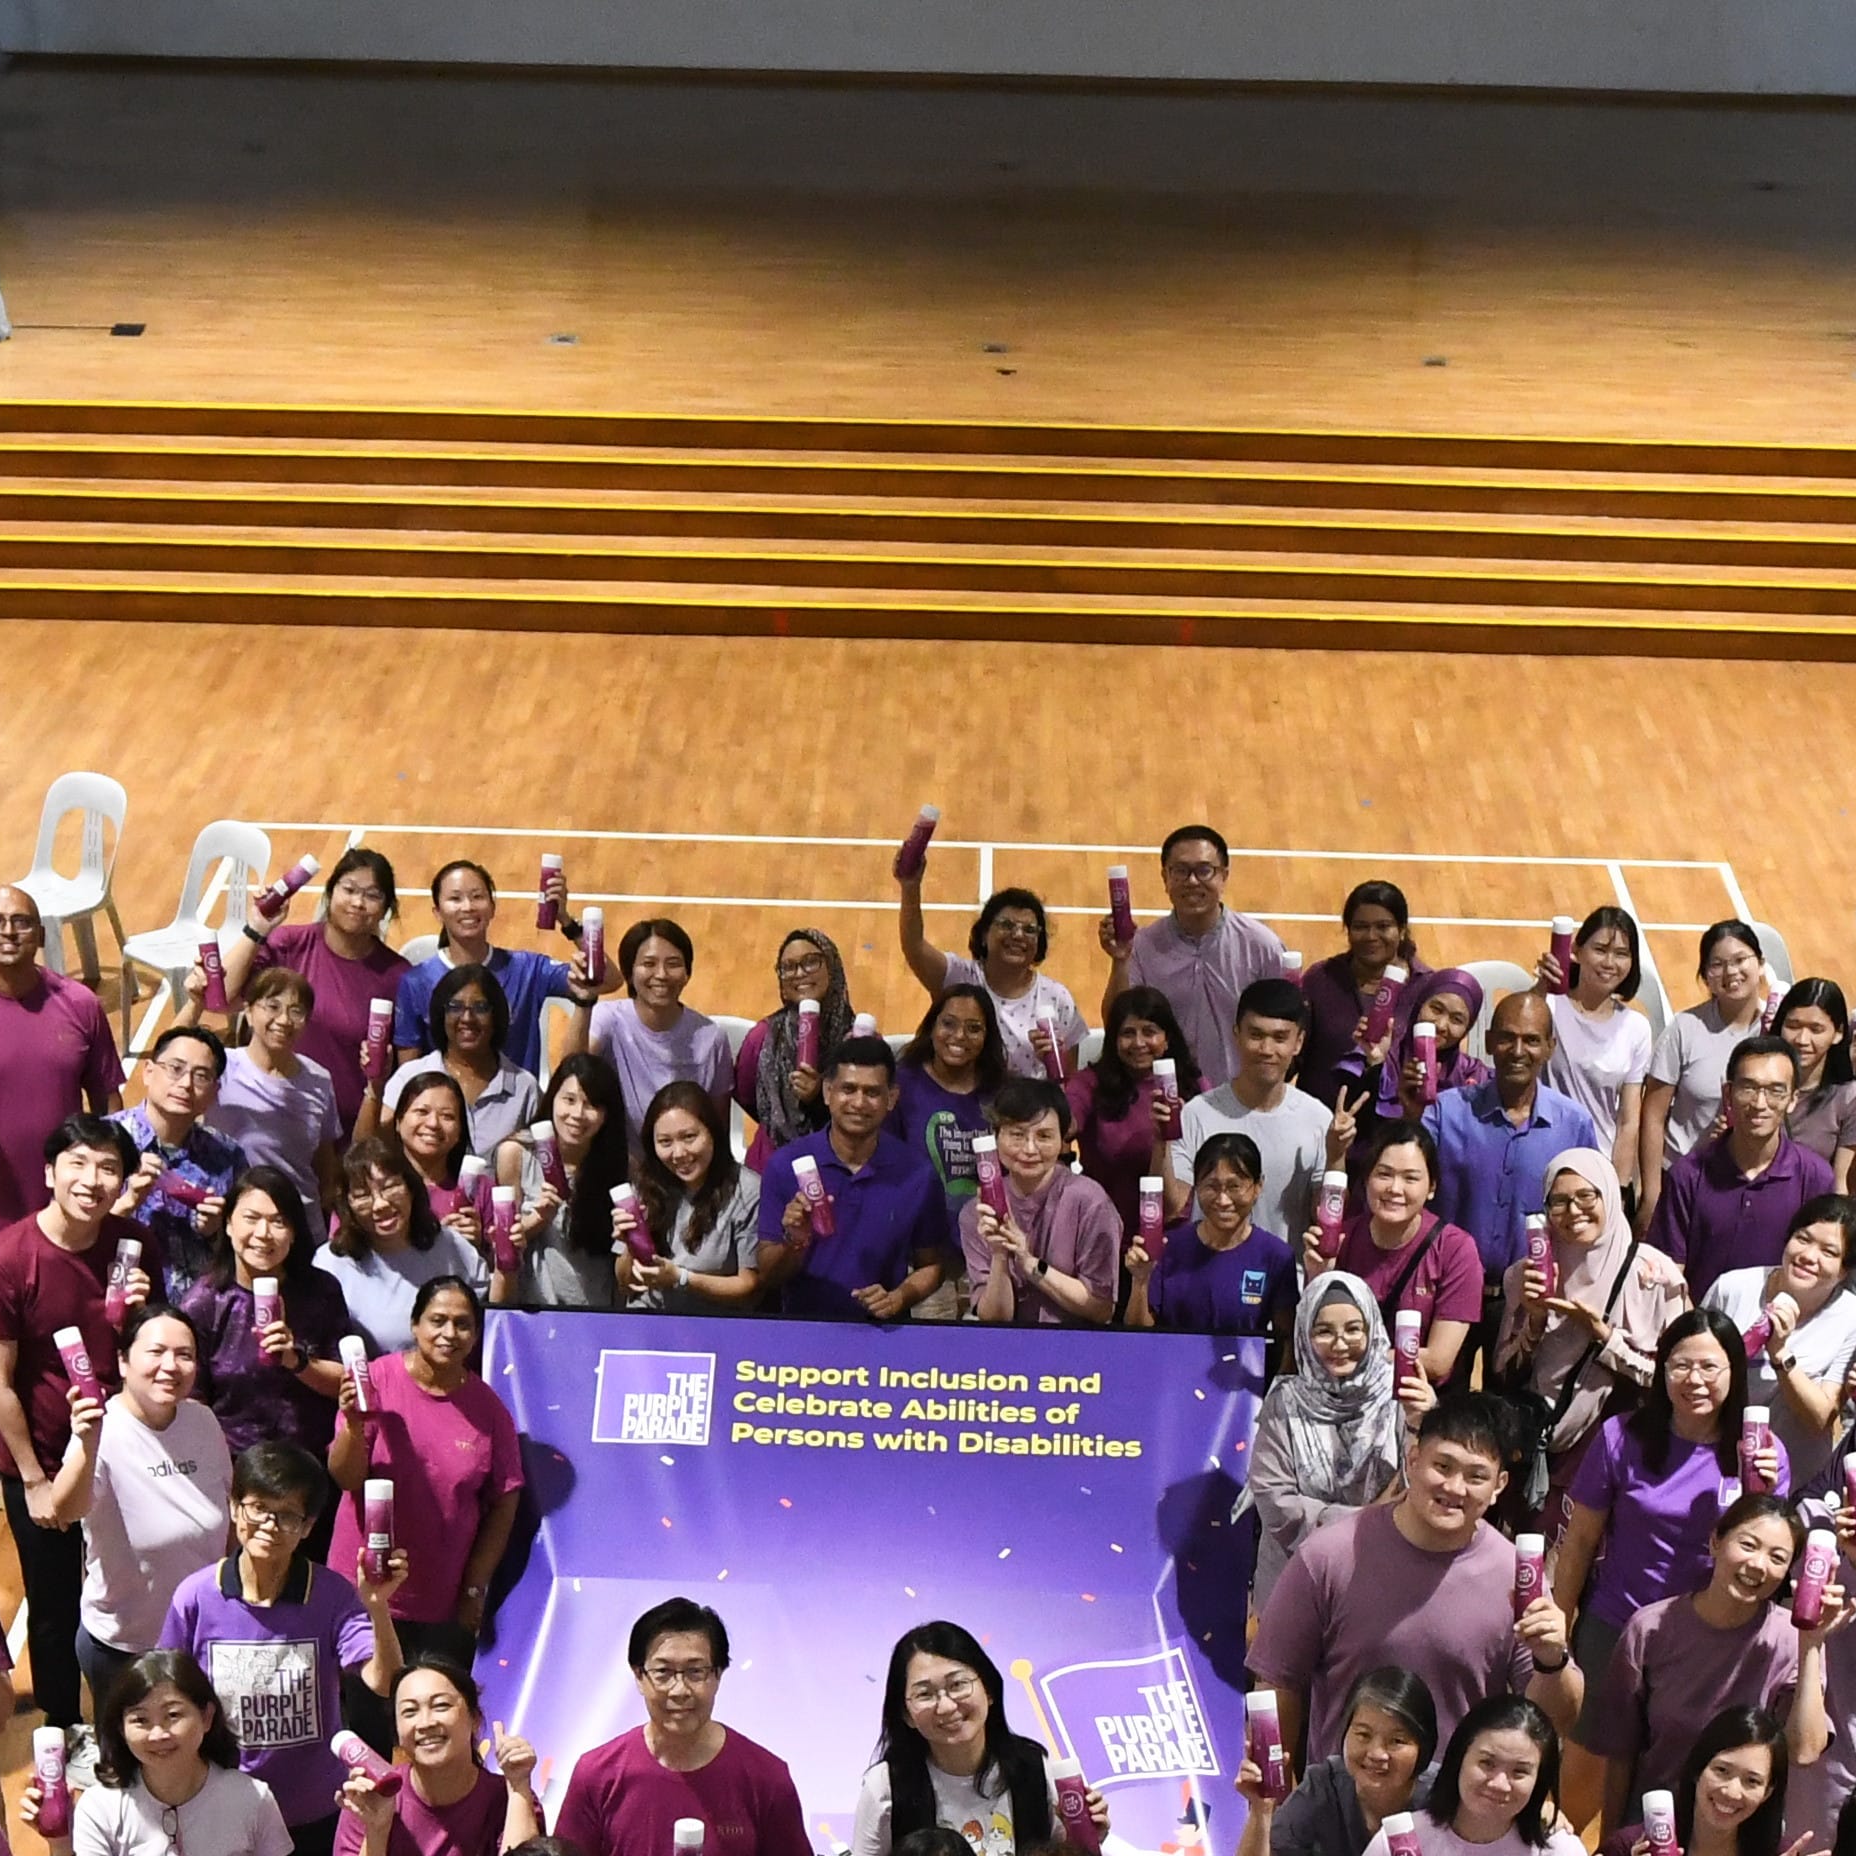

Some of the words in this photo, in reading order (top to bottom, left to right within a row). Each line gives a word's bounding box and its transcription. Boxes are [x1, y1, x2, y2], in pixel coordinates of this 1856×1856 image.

[666, 1372, 709, 1398] THE
[735, 1360, 869, 1388] Support
[879, 1366, 1029, 1392] Inclusion
[1038, 1372, 1102, 1395] and
[623, 1393, 707, 1419] PURPLE
[732, 1391, 893, 1419] Celebrate
[900, 1398, 1037, 1424] Abilities
[1045, 1402, 1081, 1425] of
[621, 1415, 705, 1441] PARADE
[730, 1421, 865, 1450] Persons
[873, 1428, 949, 1453] with
[958, 1431, 1143, 1458] Disabilities
[275, 1667, 313, 1695] THE
[240, 1691, 313, 1719] PURPLE
[1137, 1680, 1195, 1715] THE
[242, 1713, 315, 1743] PARADE
[1094, 1709, 1204, 1745] PURPLE
[1104, 1738, 1212, 1774] PARADE
